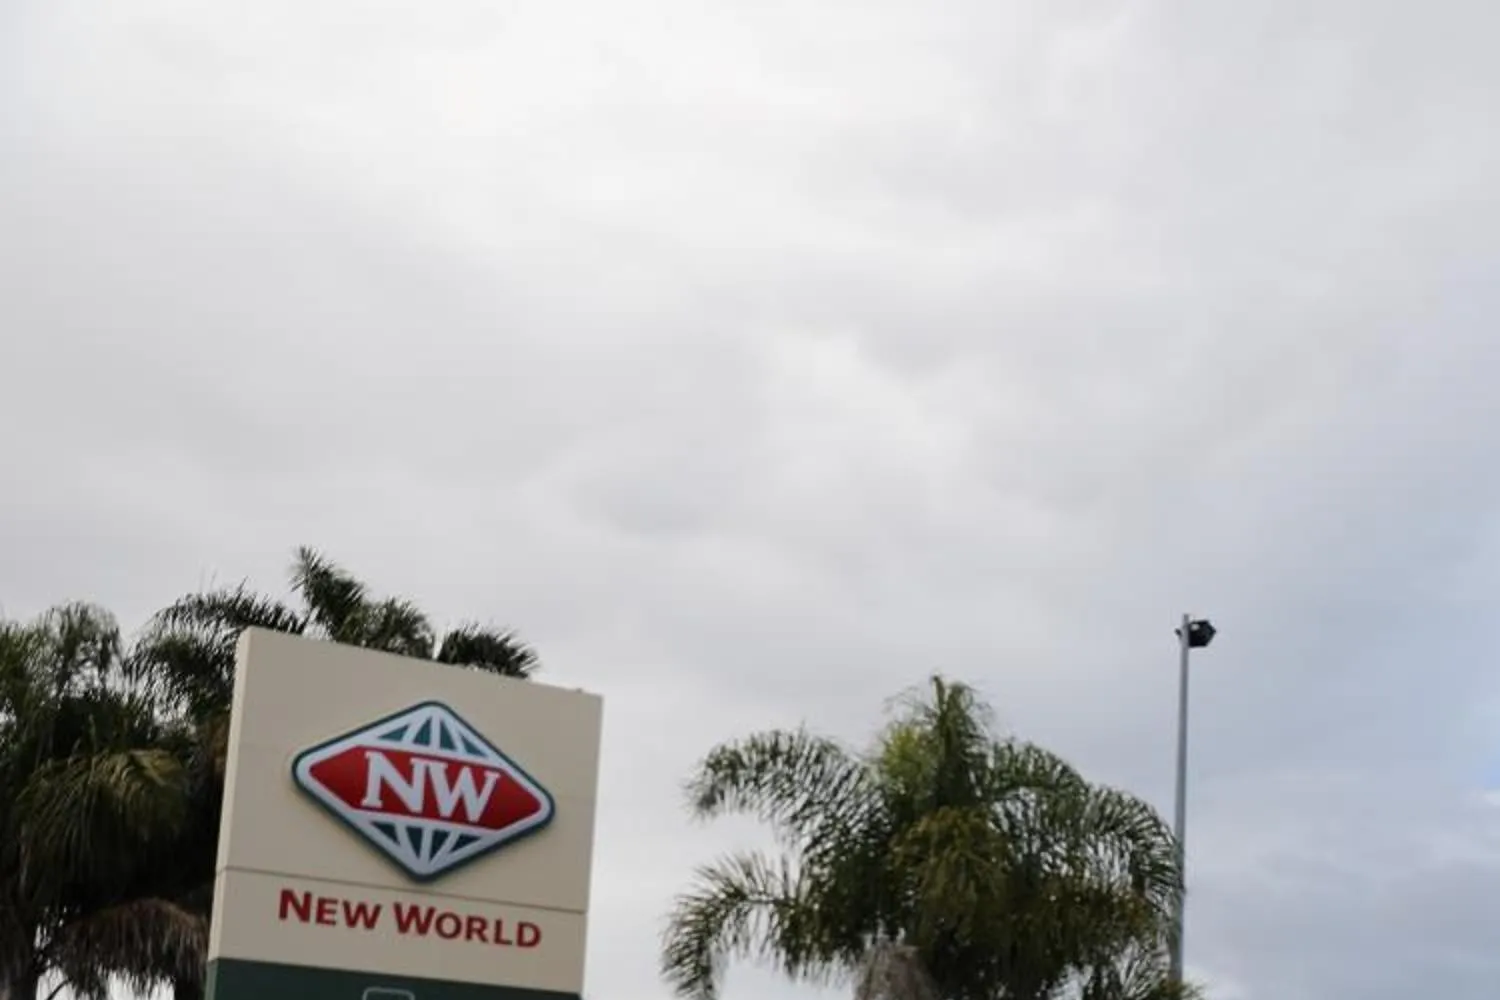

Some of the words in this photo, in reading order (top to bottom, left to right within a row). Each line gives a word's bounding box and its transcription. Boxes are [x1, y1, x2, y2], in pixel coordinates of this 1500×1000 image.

[361, 751, 501, 823] NW
[278, 888, 382, 930] NEW
[393, 901, 542, 949] WORLD
